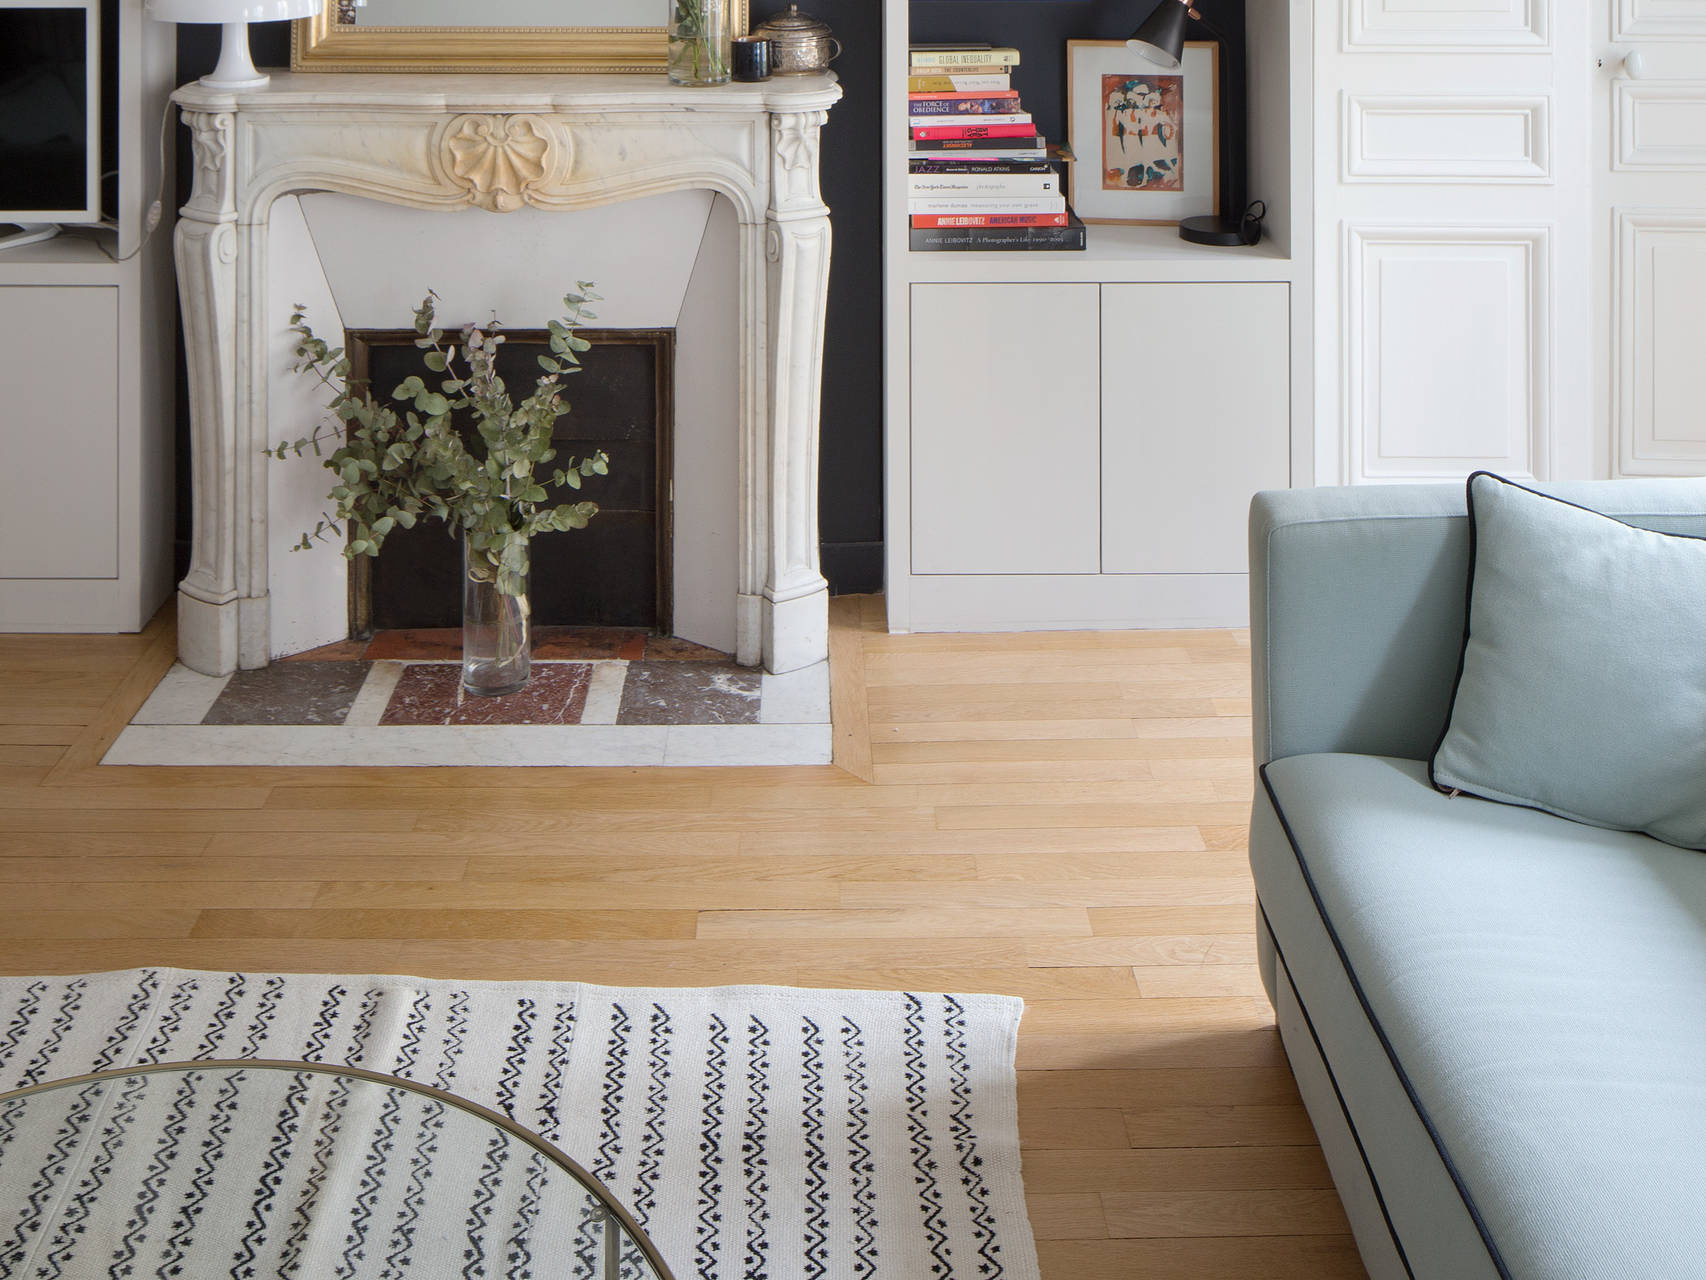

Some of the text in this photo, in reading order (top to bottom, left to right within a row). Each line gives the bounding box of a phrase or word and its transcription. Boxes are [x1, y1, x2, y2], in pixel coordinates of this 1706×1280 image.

[938, 55, 960, 65] GLOBAL
[960, 54, 993, 64] INEQUALITY
[913, 165, 940, 174] JAZZ
[936, 217, 956, 226] ANNIE
[956, 216, 985, 225] LEIBOVITZ
[989, 216, 1018, 224] AMERICAN
